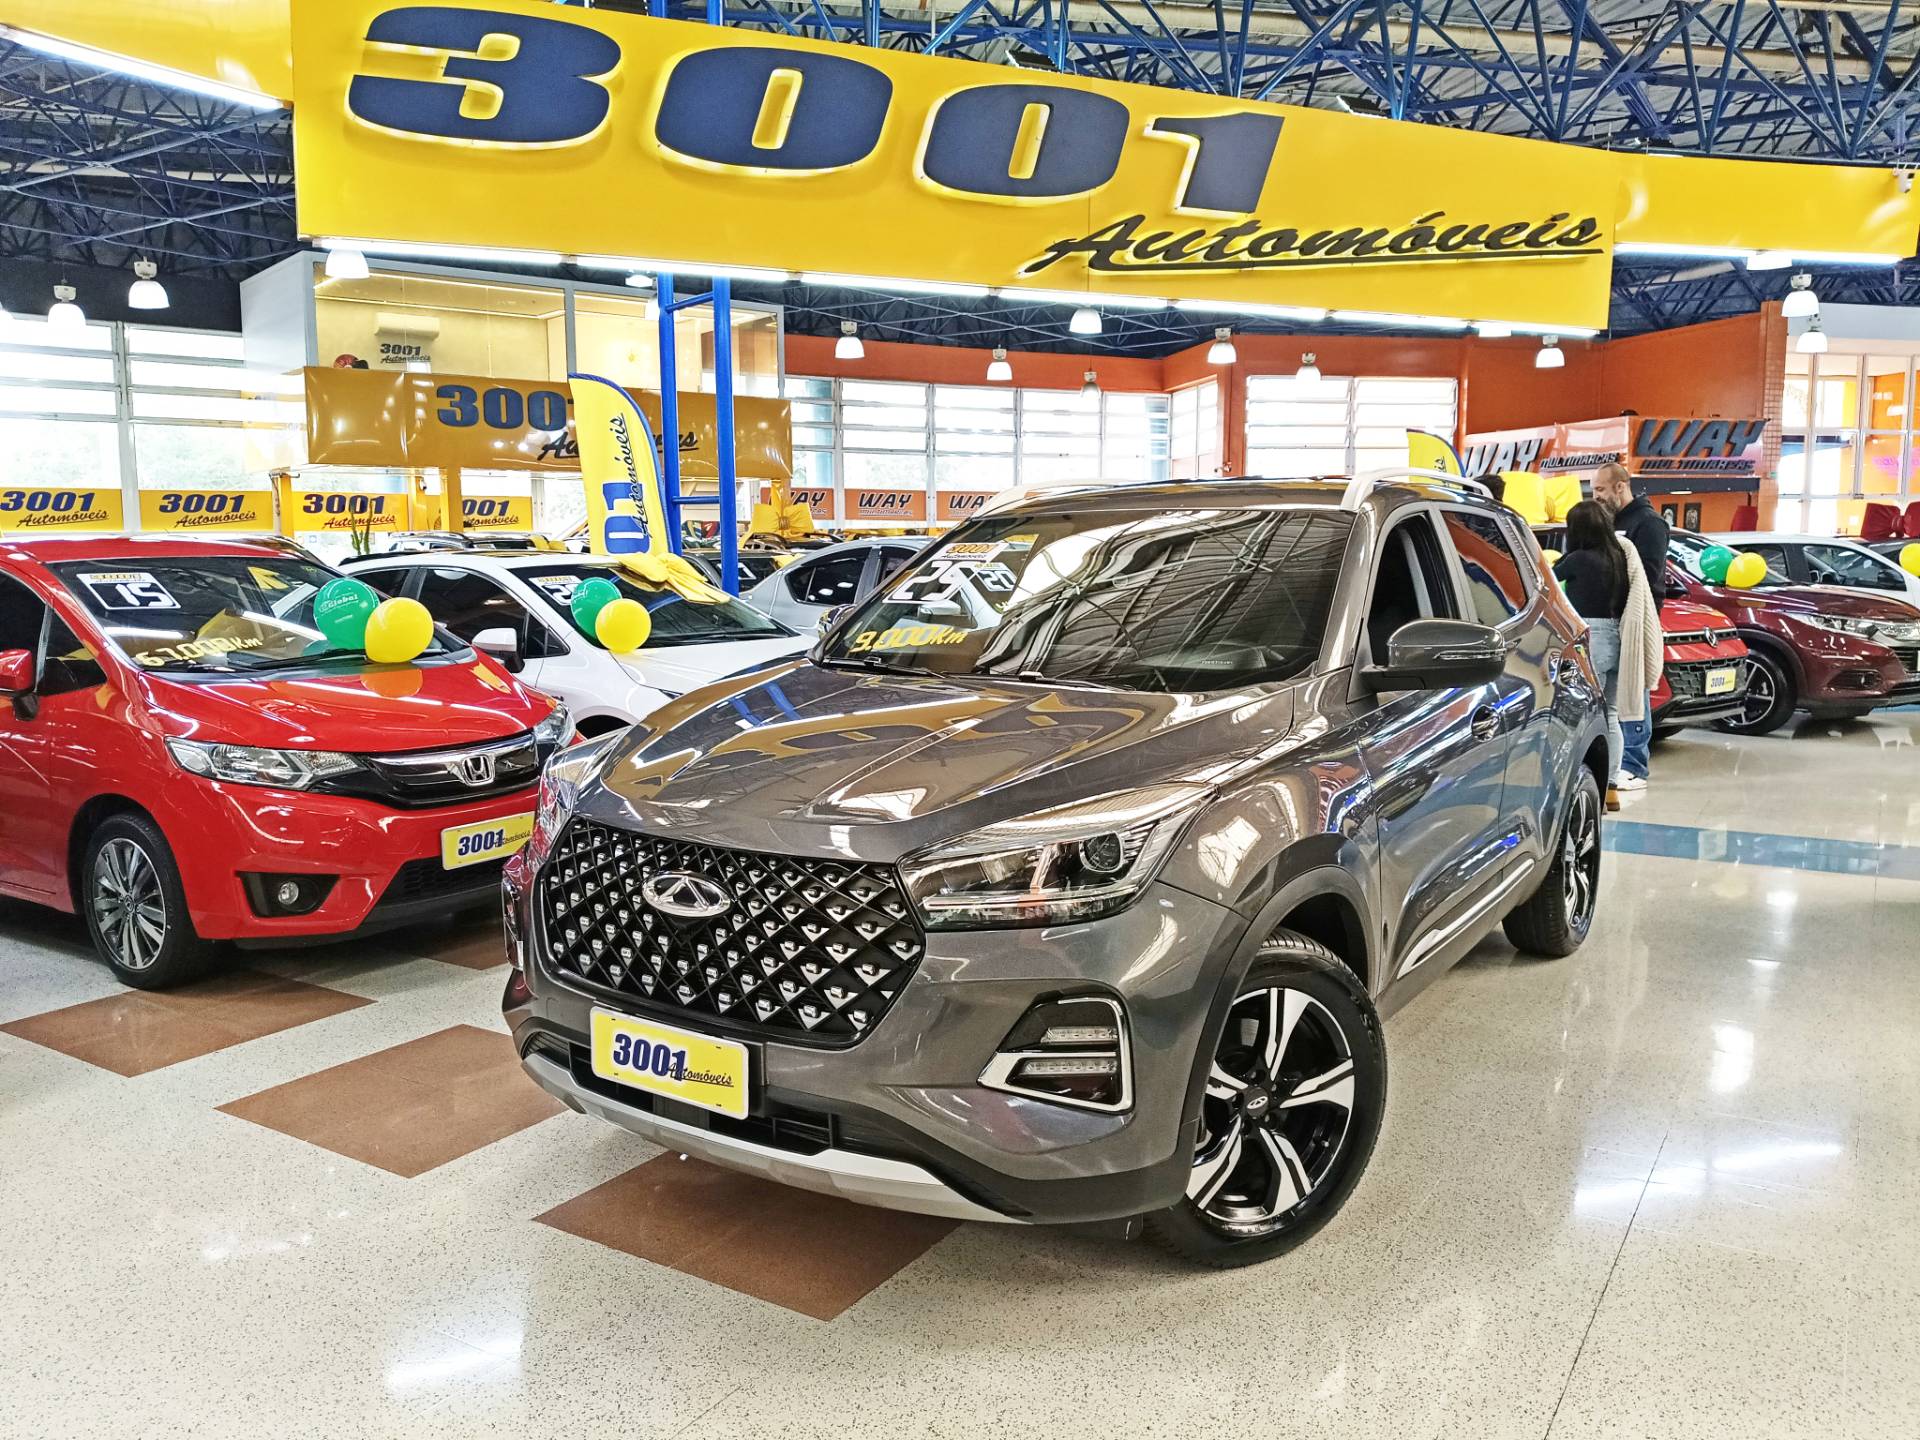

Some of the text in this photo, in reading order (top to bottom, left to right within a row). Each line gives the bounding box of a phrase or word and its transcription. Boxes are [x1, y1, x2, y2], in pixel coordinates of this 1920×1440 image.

[349, 6, 1284, 214] 3001
[1019, 211, 1603, 273] Automóveis
[380, 343, 421, 356] 3001
[437, 385, 574, 431] 300
[1636, 419, 1766, 457] WAY
[1463, 438, 1543, 477] WAY
[608, 412, 652, 539] Automóveis
[0, 491, 95, 512] 3001
[159, 493, 245, 513] 3001
[303, 494, 385, 514] 3001
[463, 499, 510, 516] 001
[859, 493, 912, 508] WAY
[949, 495, 993, 509] WA
[16, 510, 109, 528] Automóveis
[174, 511, 258, 528] Automóveis
[458, 829, 504, 856] 3001
[613, 1033, 686, 1082] 3001
